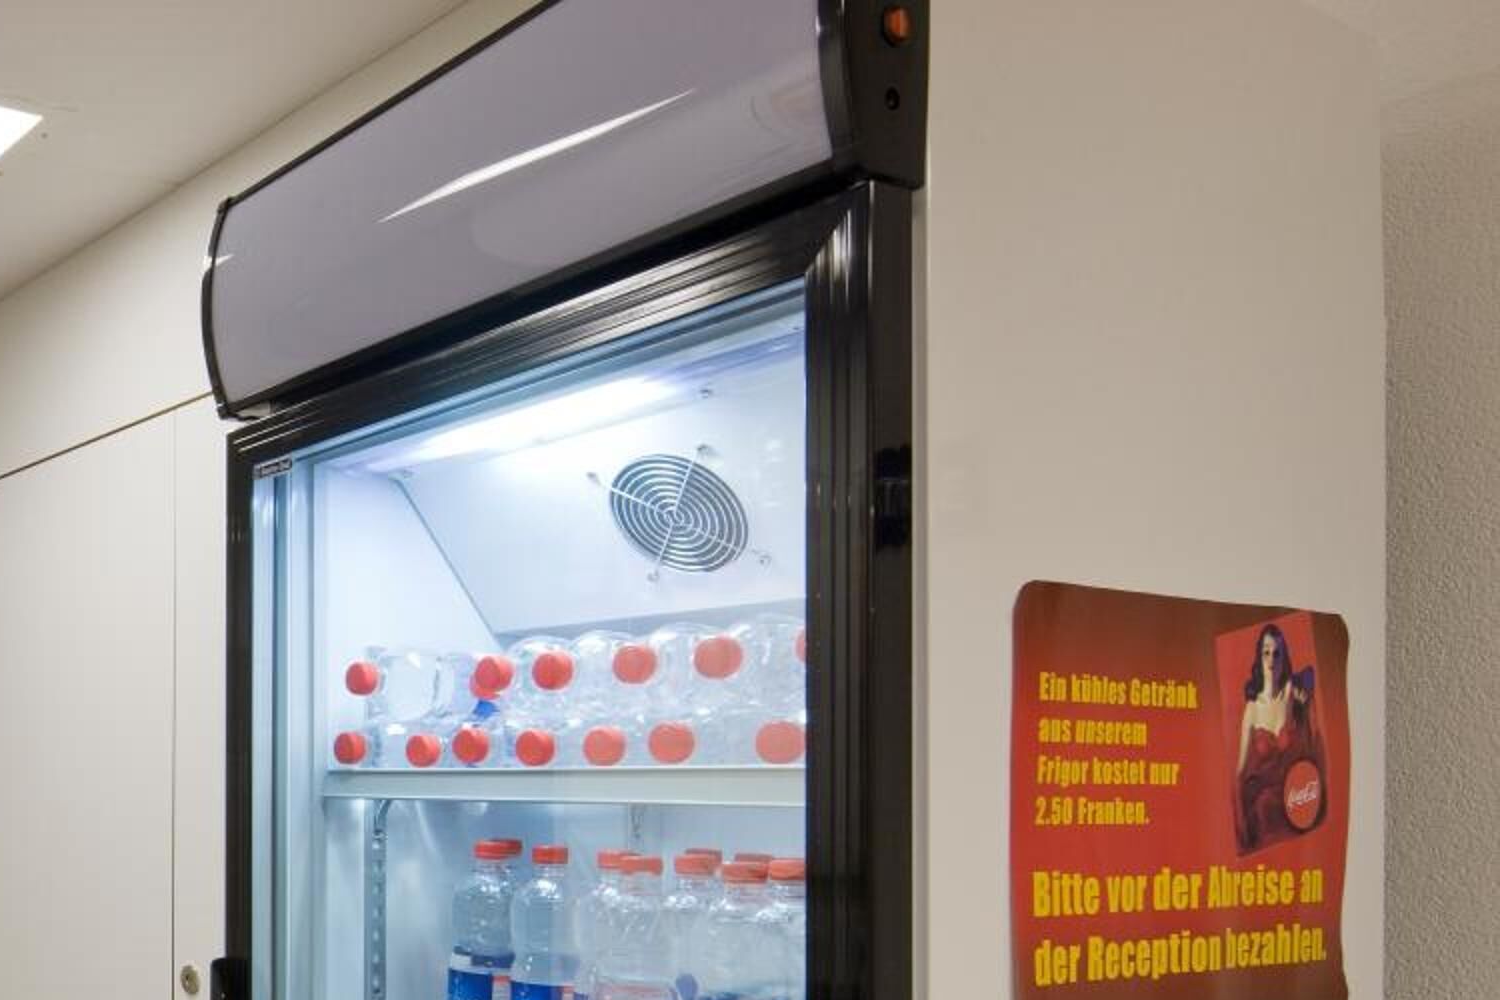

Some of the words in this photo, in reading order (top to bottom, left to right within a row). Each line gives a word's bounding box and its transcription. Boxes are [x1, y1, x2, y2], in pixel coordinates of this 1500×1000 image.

[1039, 671, 1067, 701] Ein
[1071, 674, 1127, 705] kühles
[1129, 677, 1198, 709] Getränk
[1038, 717, 1071, 743] aus
[1075, 719, 1147, 747] unserem
[1037, 755, 1089, 788] Frigor
[1092, 756, 1147, 785] kostet
[1150, 763, 1180, 785] nur
[1035, 797, 1073, 825] 2.50
[1076, 797, 1151, 825] Franken.
[1032, 870, 1100, 917] Bitte
[1106, 875, 1147, 913] vor
[1153, 866, 1202, 911] der
[1207, 864, 1295, 909] Abreise
[1300, 869, 1323, 903] an
[1034, 939, 1081, 987] der
[1086, 929, 1221, 981] Reception
[1225, 923, 1327, 969] bezahlen.
